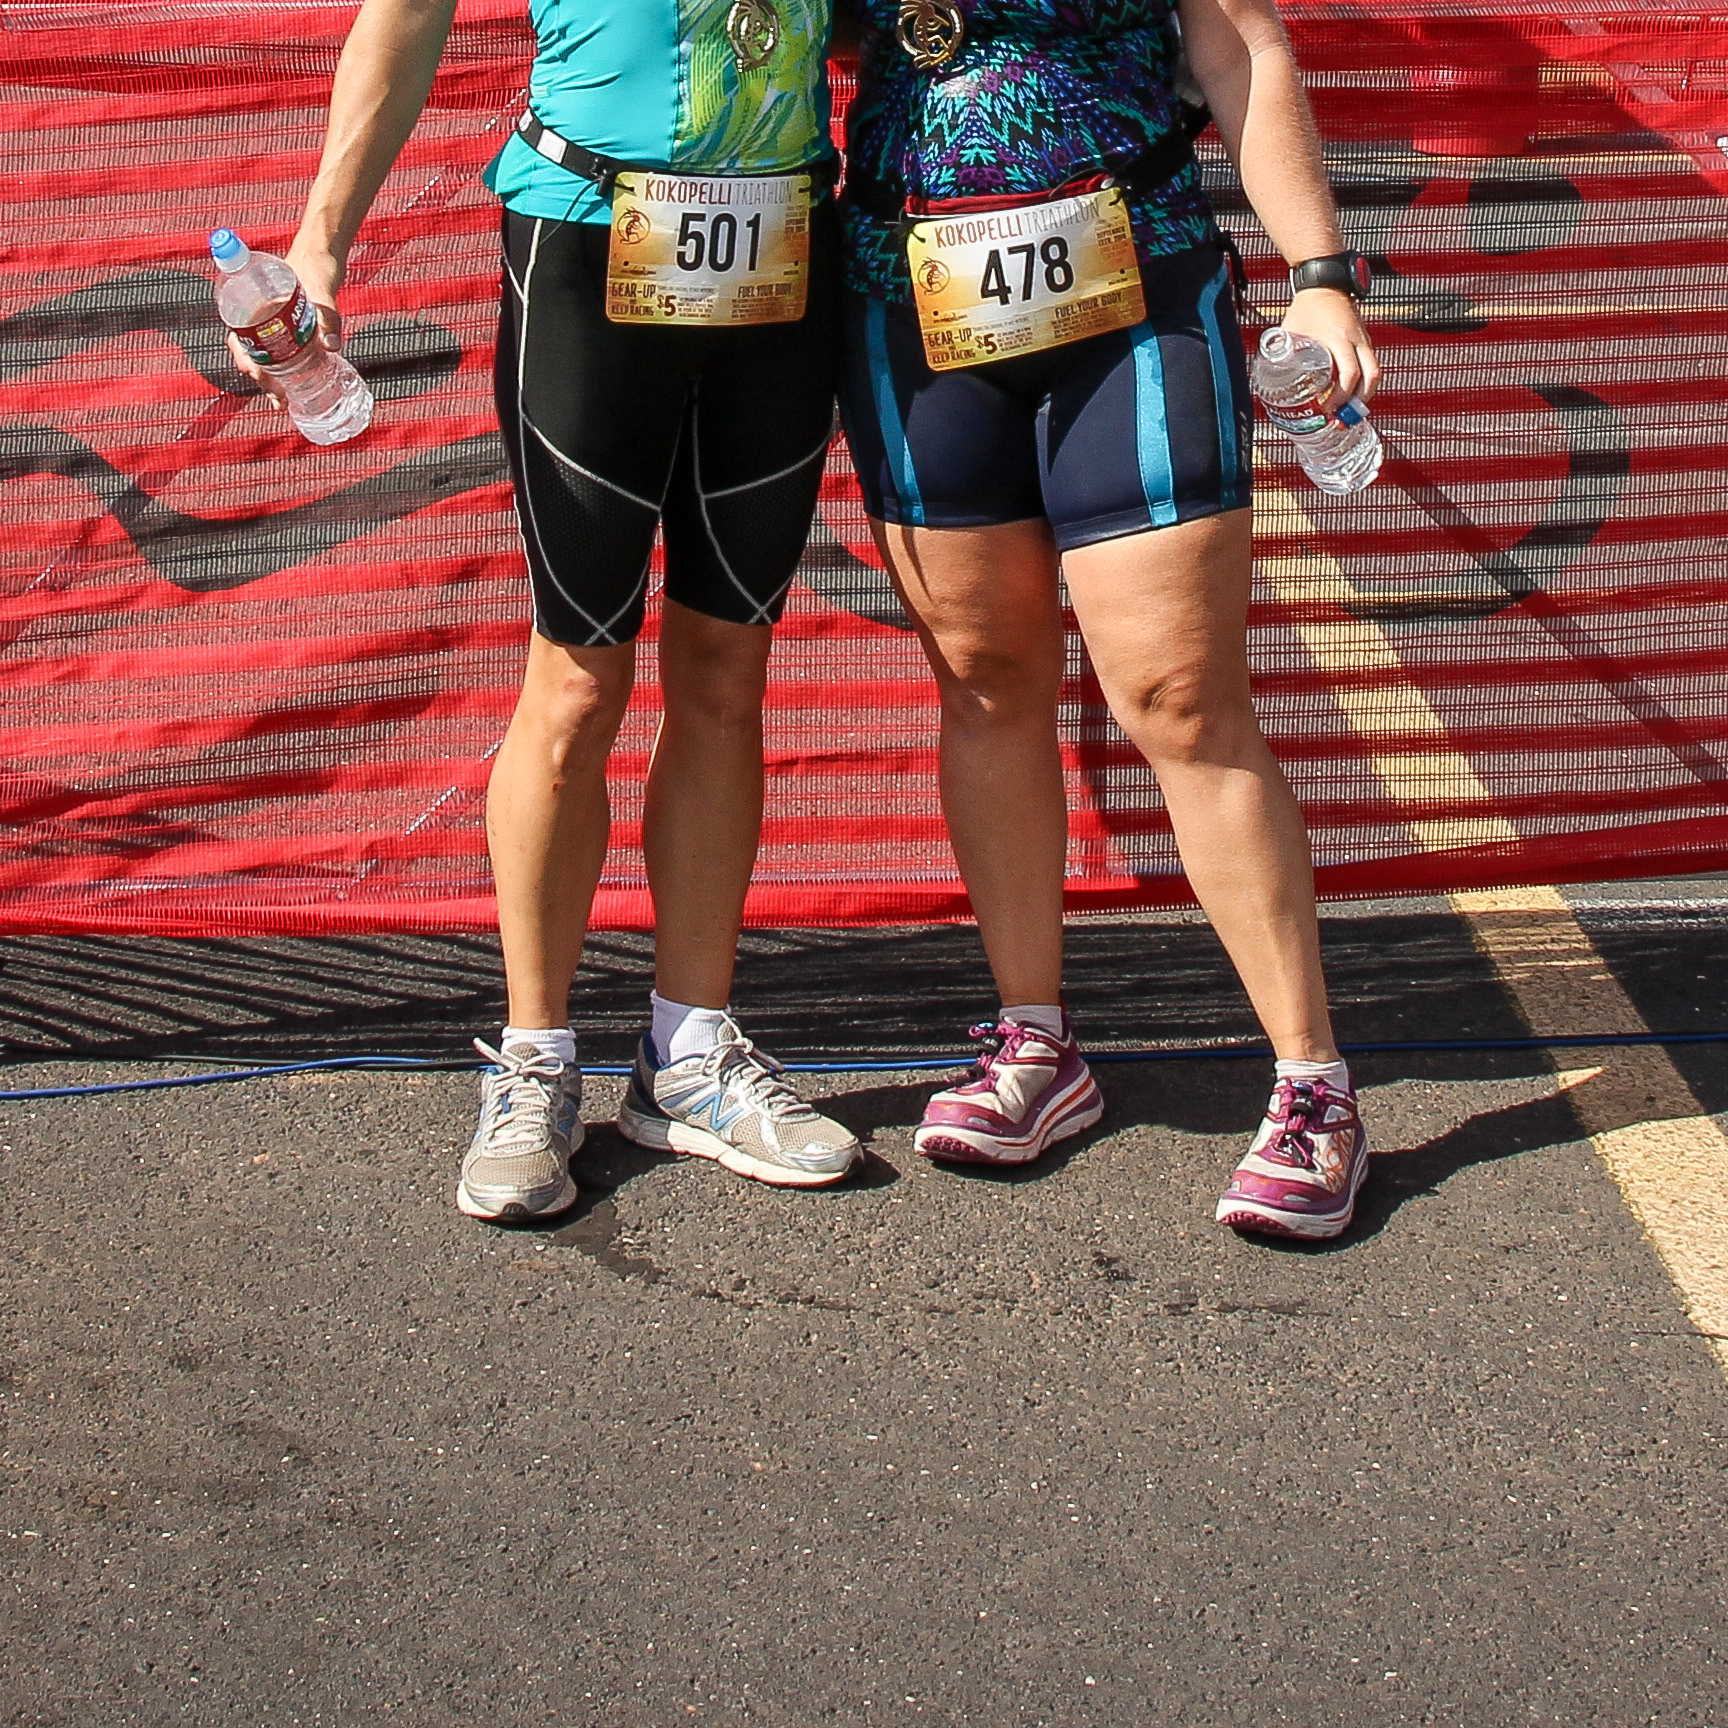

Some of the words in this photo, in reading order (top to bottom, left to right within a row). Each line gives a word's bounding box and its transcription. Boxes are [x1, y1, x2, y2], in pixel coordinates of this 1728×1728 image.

[645, 178, 732, 205] KOKOPELLI
[735, 180, 793, 206] TRIATHLON
[935, 215, 1023, 248] KOKOPELLI
[1026, 197, 1100, 234] TRIATHLON
[676, 212, 761, 272] 501
[980, 236, 1074, 306] 478
[611, 283, 656, 297] GEAR-UP
[657, 295, 677, 316] $5
[1055, 304, 1076, 318] FUEL
[1076, 299, 1098, 314] YOUR
[928, 328, 972, 347] GEAR-UP
[975, 333, 998, 354] $5
[950, 348, 976, 362] RACING
